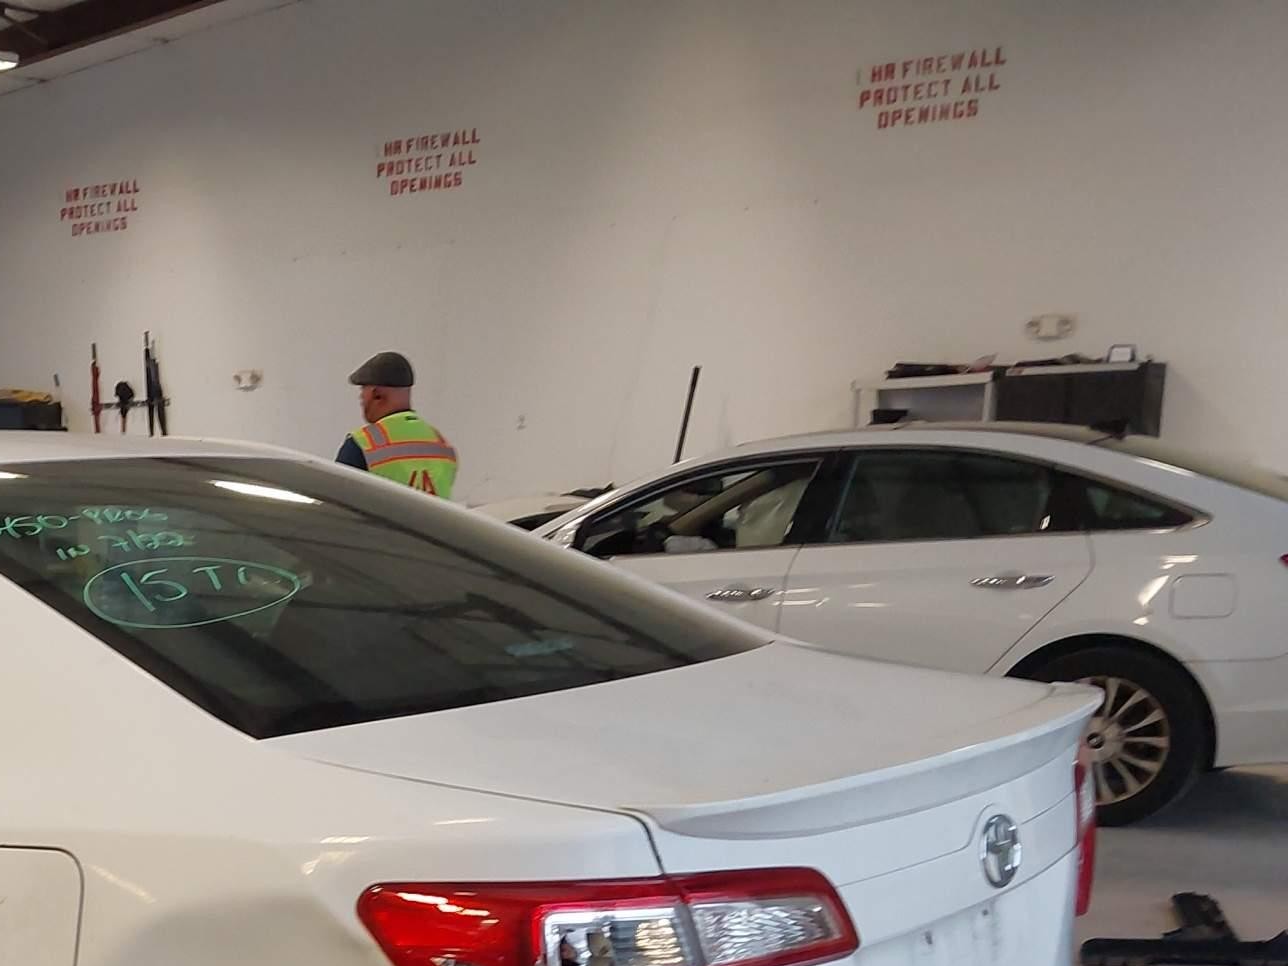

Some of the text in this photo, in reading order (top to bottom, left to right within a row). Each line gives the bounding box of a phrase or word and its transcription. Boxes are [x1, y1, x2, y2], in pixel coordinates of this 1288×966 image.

[871, 63, 896, 83] HR
[902, 46, 1007, 79] FIREWALL
[859, 73, 1001, 109] PROTECT ALL
[877, 99, 979, 130] OPENINGS
[407, 128, 480, 154] FIREWALL
[376, 150, 477, 178] PROTECT ALL
[82, 180, 139, 201] FIREWALL
[390, 171, 463, 196] OPENINGS
[60, 198, 138, 221] PROTECT ALL
[72, 216, 128, 237] OPENINGS
